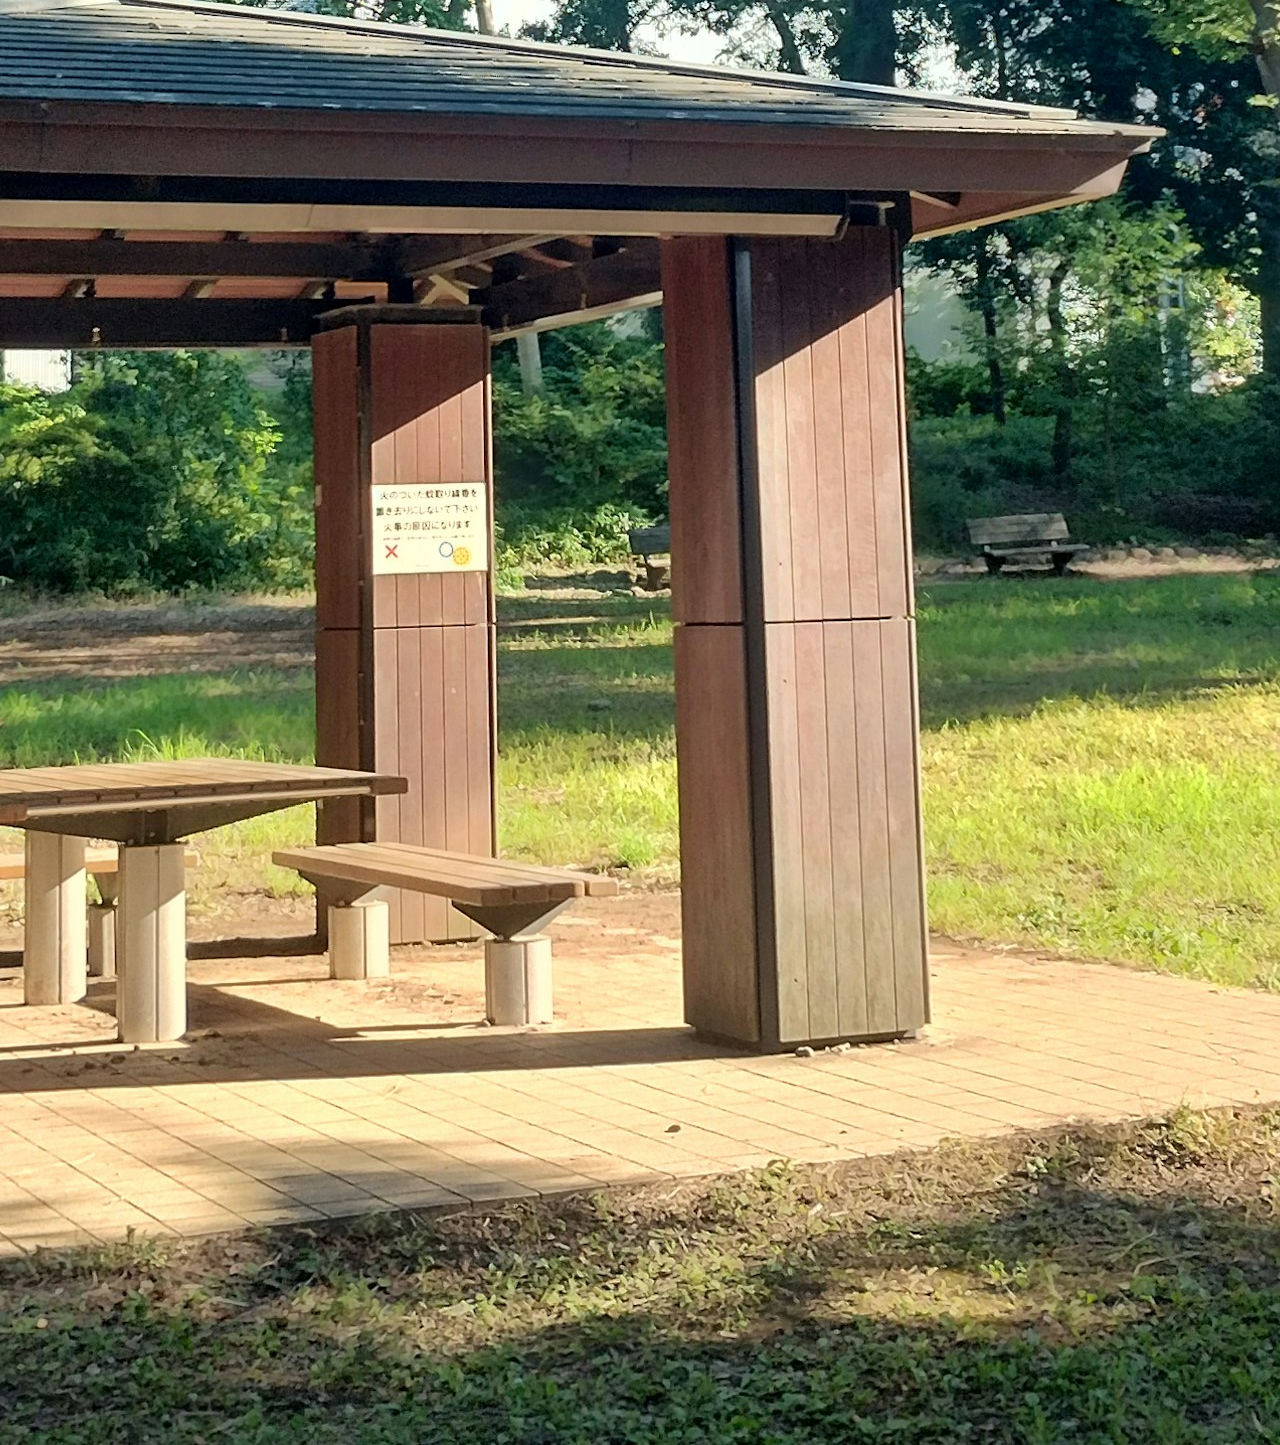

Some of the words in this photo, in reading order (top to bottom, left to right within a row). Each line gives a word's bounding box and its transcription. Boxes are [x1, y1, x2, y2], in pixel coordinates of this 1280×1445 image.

[384, 520, 471, 532] 火事の原因になります
